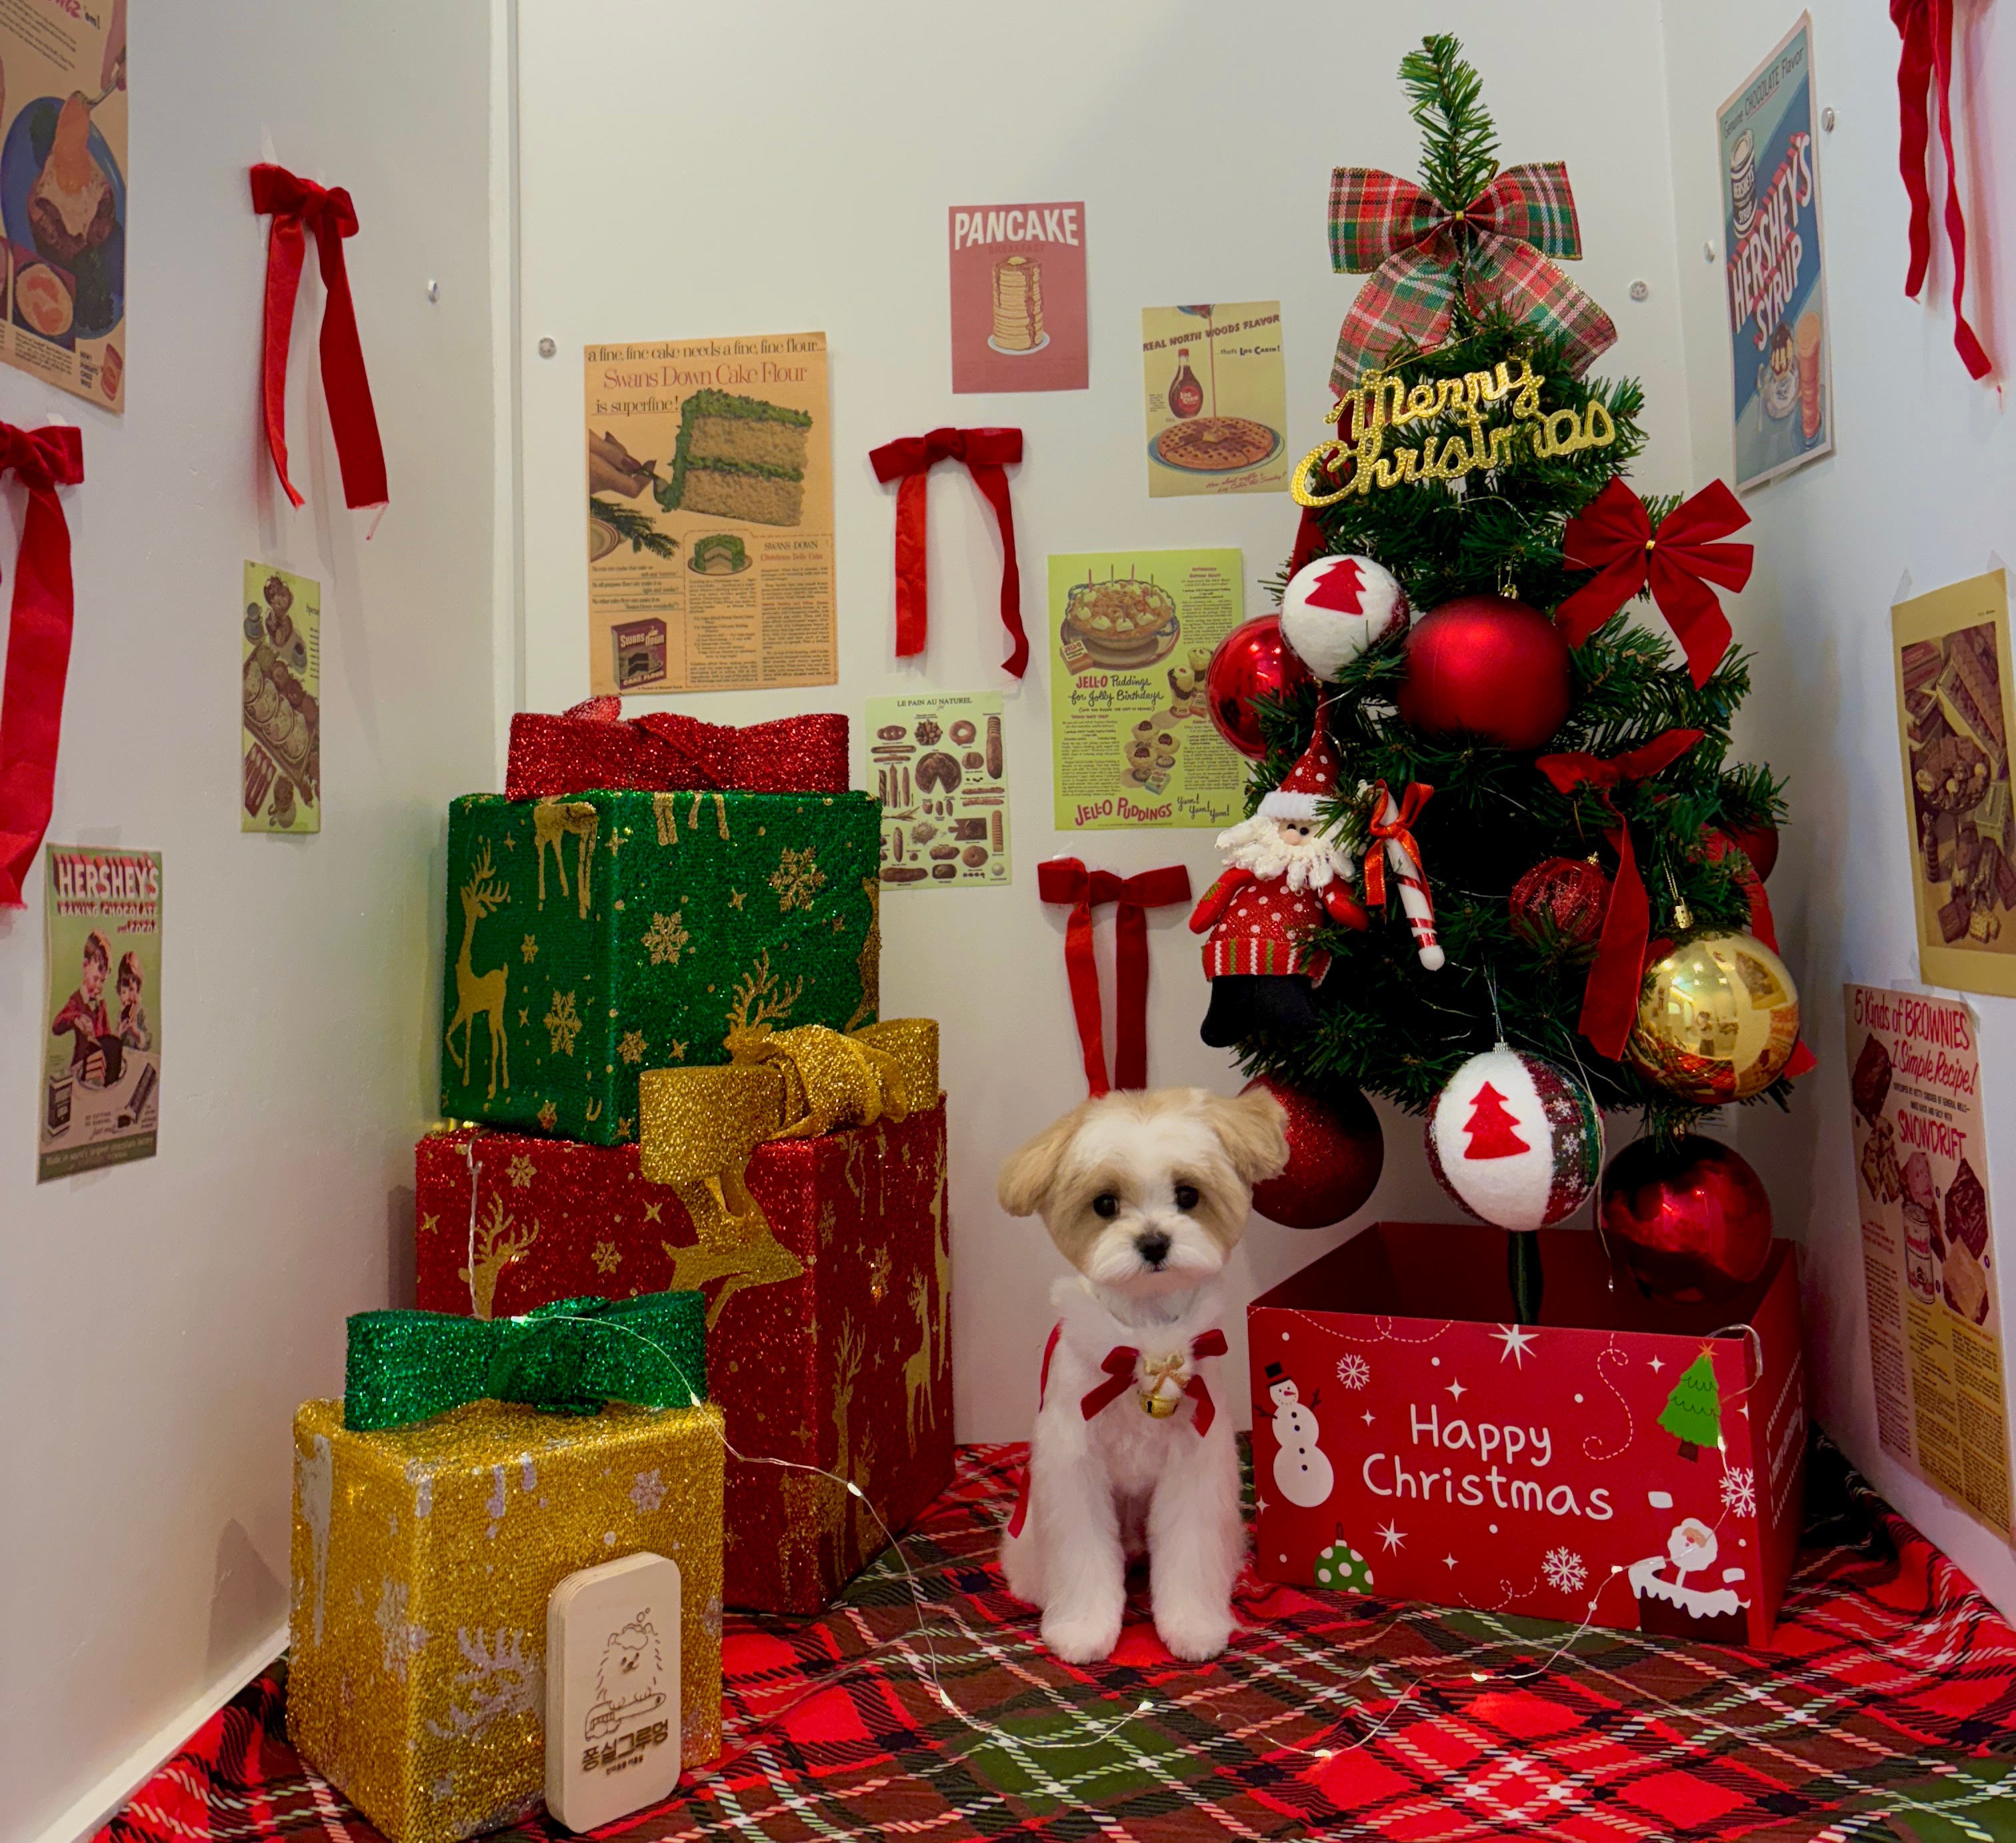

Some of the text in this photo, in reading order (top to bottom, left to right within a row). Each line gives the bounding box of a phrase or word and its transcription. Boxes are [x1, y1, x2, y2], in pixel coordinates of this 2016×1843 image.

[1723, 47, 1804, 139] Genuine CHOCOLATE Flavor
[955, 208, 1079, 251] PANCAKE
[1731, 133, 1811, 335] HERSHEY'S
[989, 243, 1045, 255] BREAKFAST
[1755, 235, 1803, 352] SYRUP
[588, 338, 826, 362] a fine, fine cake needs a fine, fine flour...
[1143, 314, 1280, 352] REAL NORTH WOODS FLAVOR
[603, 361, 807, 389] Swans Down Cake Flour
[596, 395, 678, 417] is superfine!
[1323, 359, 1547, 441] Merry
[1291, 400, 1616, 509] Christmas
[764, 541, 819, 551] SWANS DOWN
[1068, 690, 1164, 707] for Jolly Birthdays
[1076, 675, 1151, 691] JELL-O Puddings
[1075, 797, 1173, 827] JELL-O PUDDINGS
[1177, 793, 1199, 811] Yum!
[1189, 801, 1210, 819] Yum!
[1209, 805, 1230, 823] Yum!
[56, 856, 159, 901] HERSHEY'S
[59, 902, 159, 919] BAKING CHOCOLATE
[128, 920, 159, 934] COCOA
[1855, 988, 1970, 1051] 5 Kinds of BROWNIES
[1891, 1039, 1979, 1098] 1 Simple Recipe!
[1897, 1108, 1967, 1161] SNOWDRIFT
[1409, 1402, 1552, 1467] Happy
[1362, 1452, 1613, 1522] Christmas
